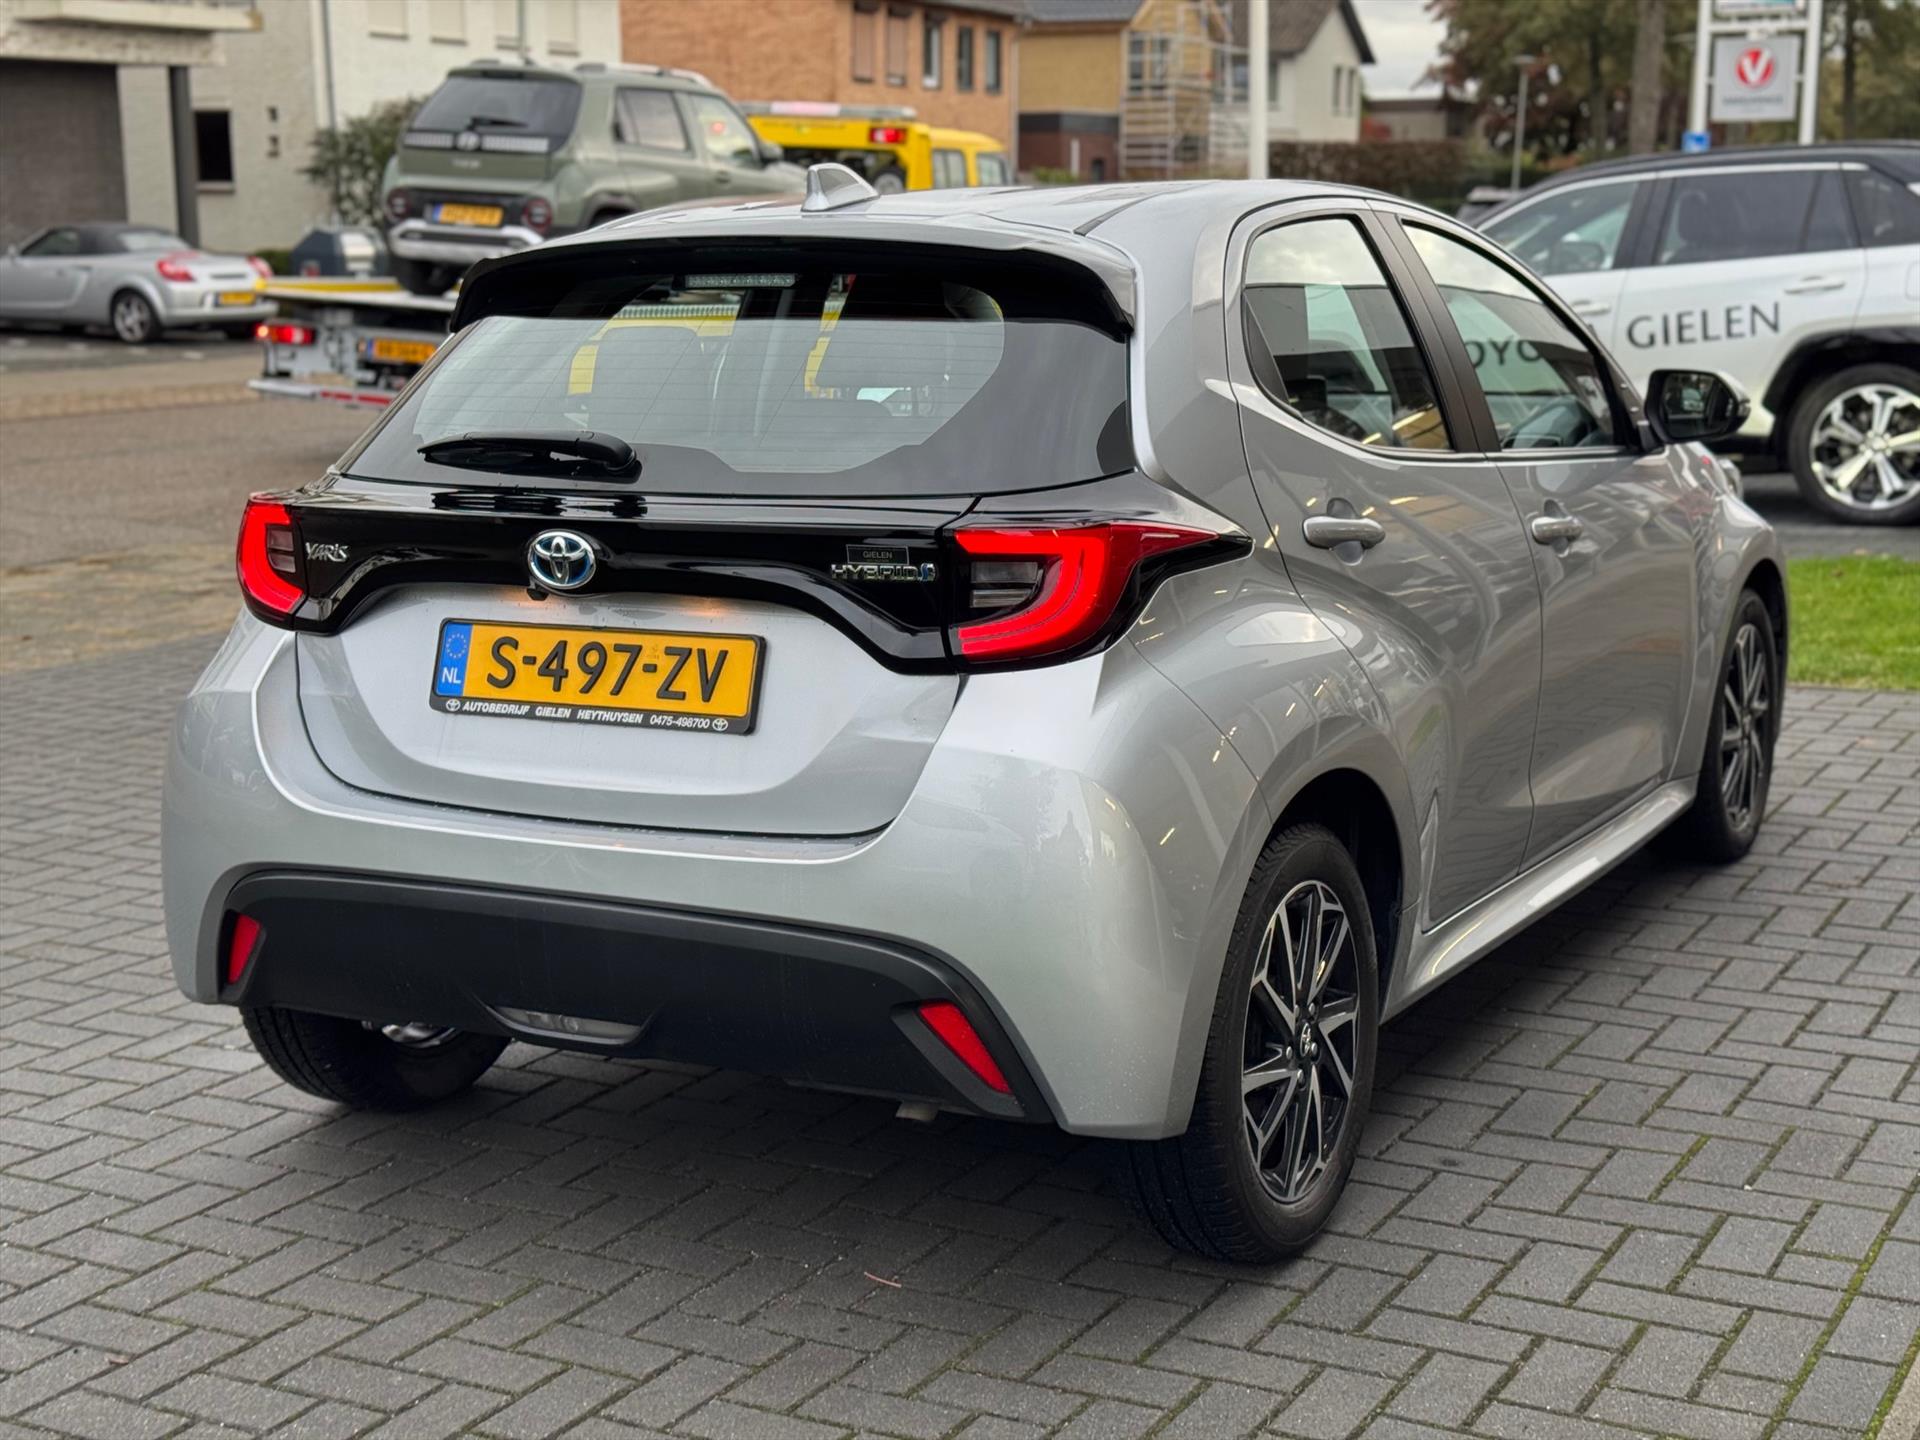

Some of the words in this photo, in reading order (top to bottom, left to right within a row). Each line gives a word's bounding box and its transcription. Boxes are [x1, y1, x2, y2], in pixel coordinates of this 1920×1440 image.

[1627, 302, 1779, 349] GIELEN
[862, 551, 893, 559] GIELEN
[831, 564, 918, 580] HYBRID
[441, 667, 462, 684] NL
[486, 636, 729, 702] S-497-ZV
[462, 701, 530, 716] AUTOBEDRIJF
[535, 706, 572, 719] GIELEN
[576, 709, 644, 724] HEYTHUYSEN
[650, 714, 711, 729] 0475-498700
